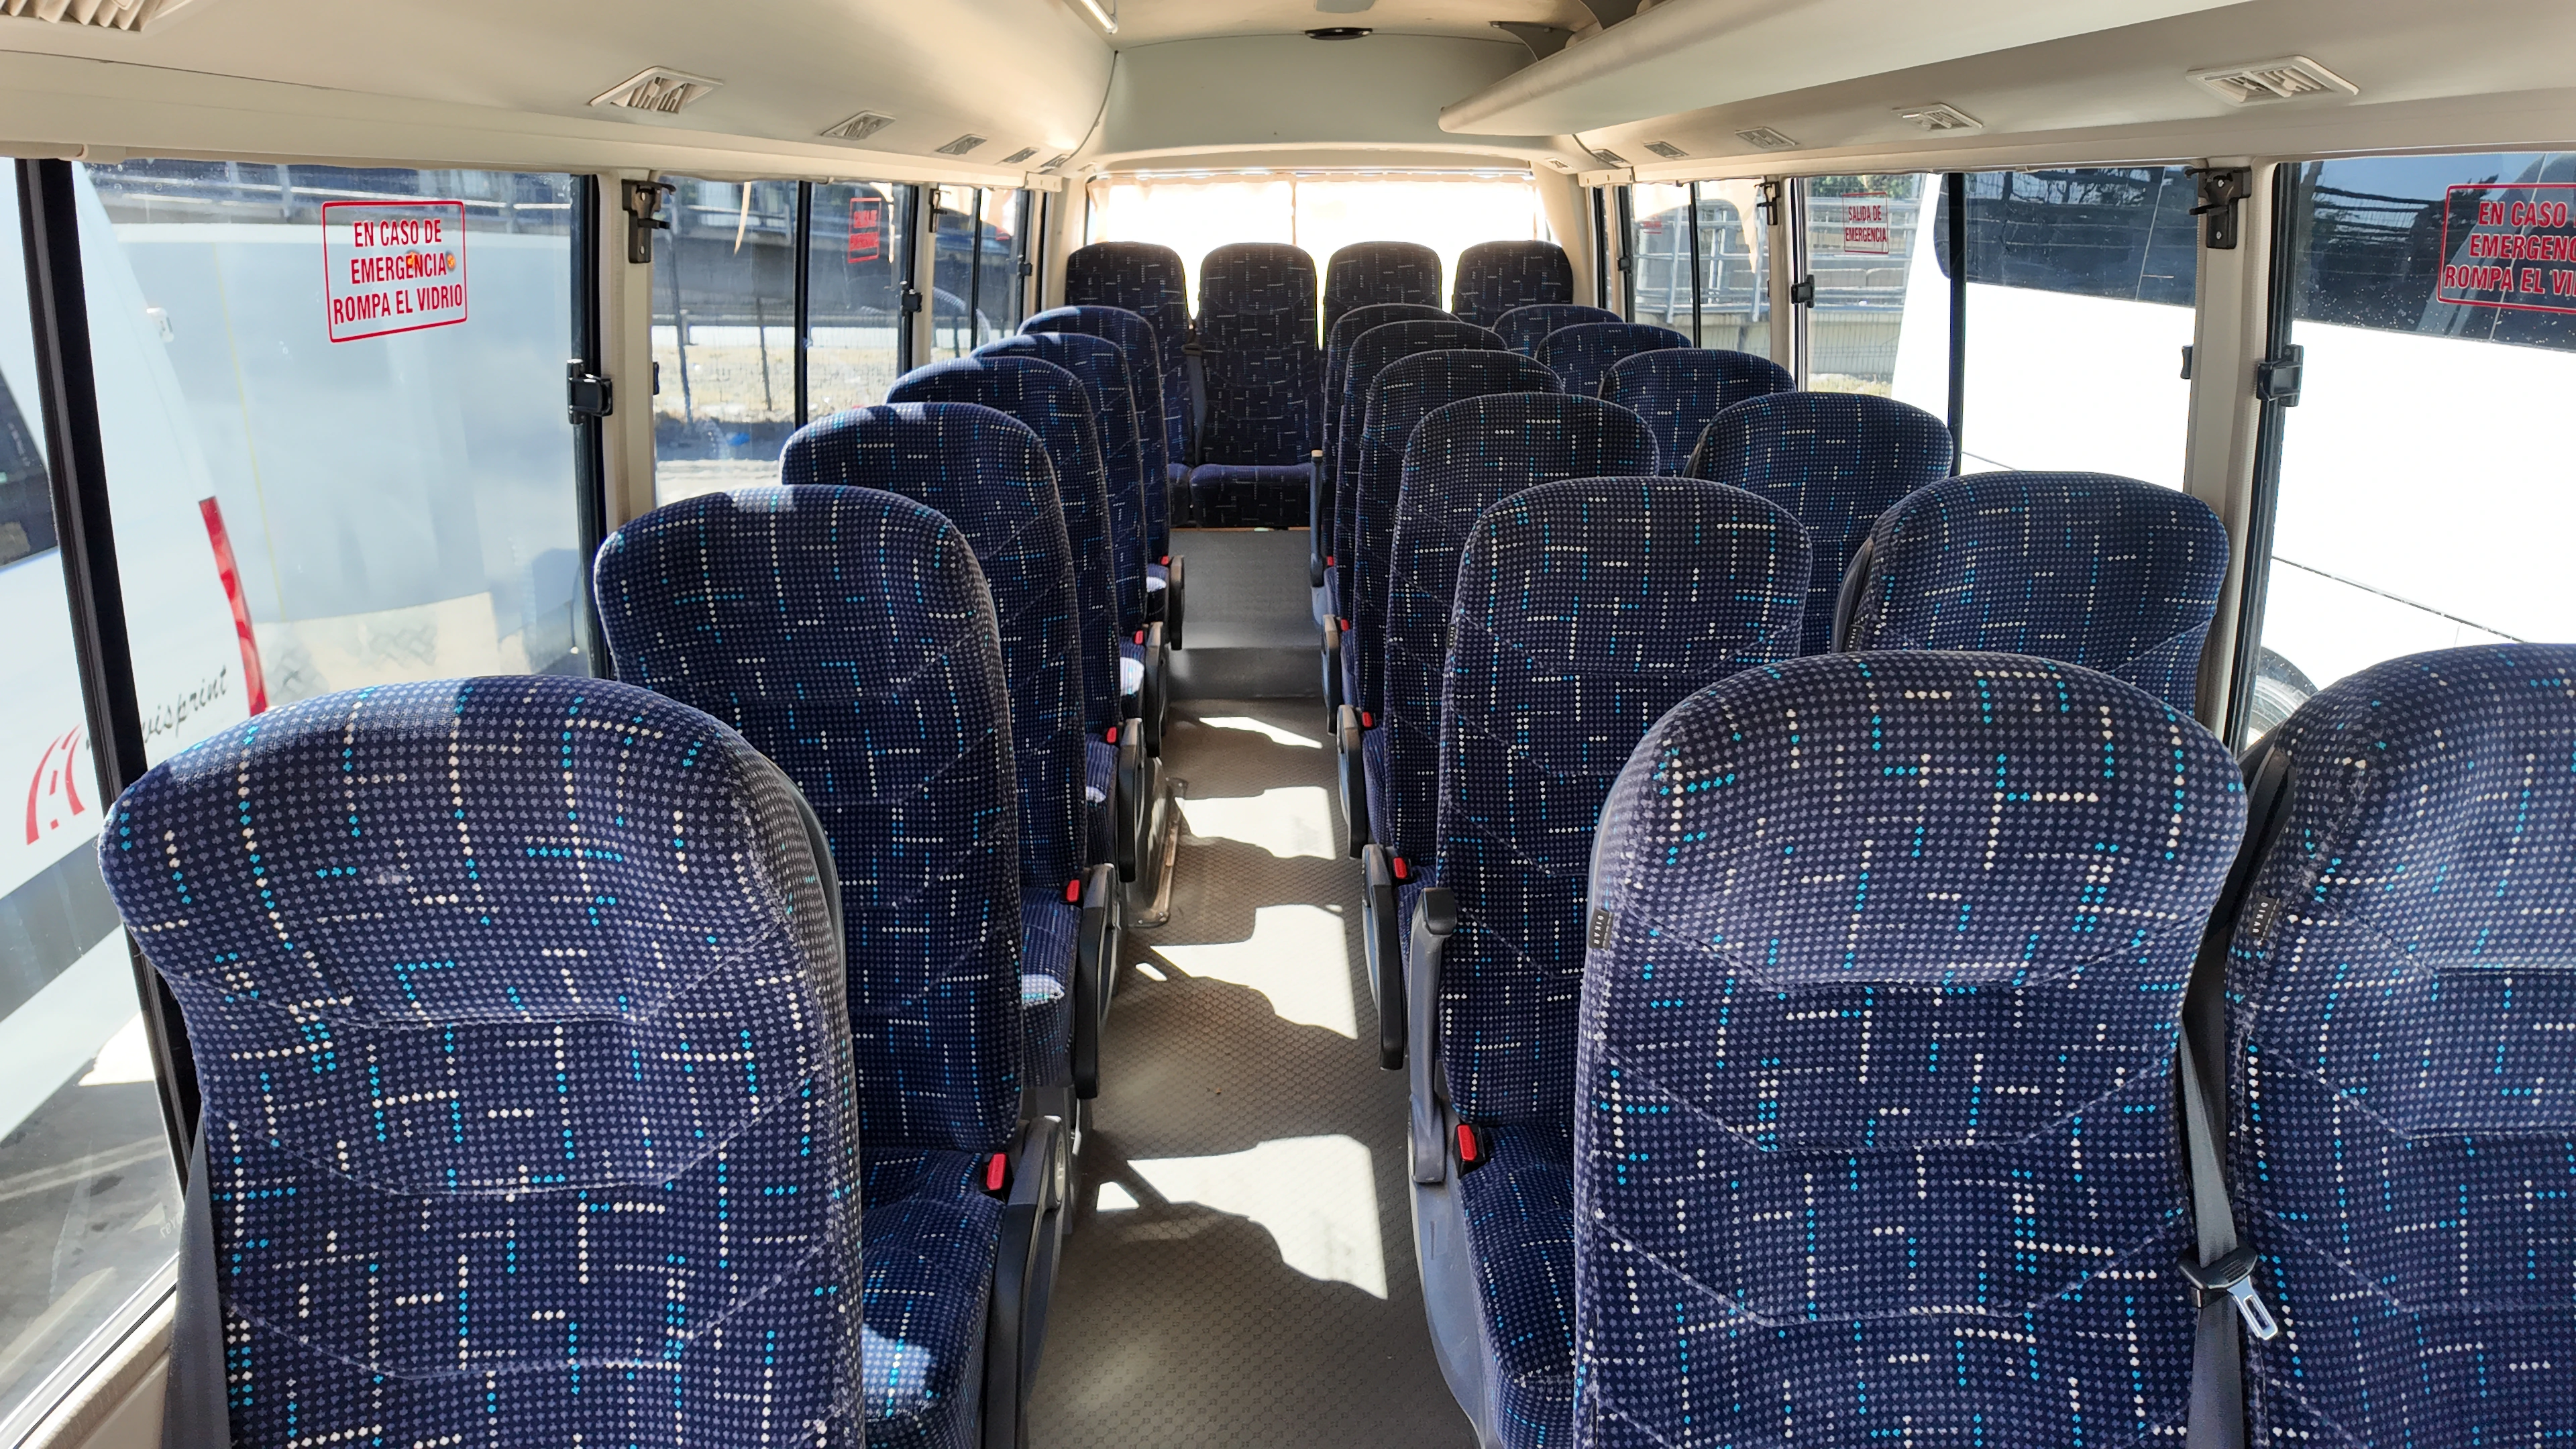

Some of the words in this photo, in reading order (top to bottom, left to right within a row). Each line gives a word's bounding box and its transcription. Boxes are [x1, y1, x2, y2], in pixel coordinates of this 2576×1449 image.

[1848, 205, 1872, 221] SALIDA
[1872, 205, 1882, 221] DE
[2478, 201, 2505, 226] EN
[2511, 201, 2568, 228] CASO
[354, 221, 374, 248] EN
[380, 219, 419, 246] CASO
[424, 219, 442, 244] DE
[1845, 227, 1887, 243] EMERGENCIA
[351, 252, 447, 284] EMERGENCIA
[2444, 264, 2514, 292] ROMPA
[2520, 268, 2546, 294] EL
[2553, 269, 2576, 297] VI
[333, 291, 391, 325] ROMPA
[396, 289, 413, 315] EL
[416, 284, 463, 311] VIDRIO
[1593, 914, 1605, 945] DIKAR
